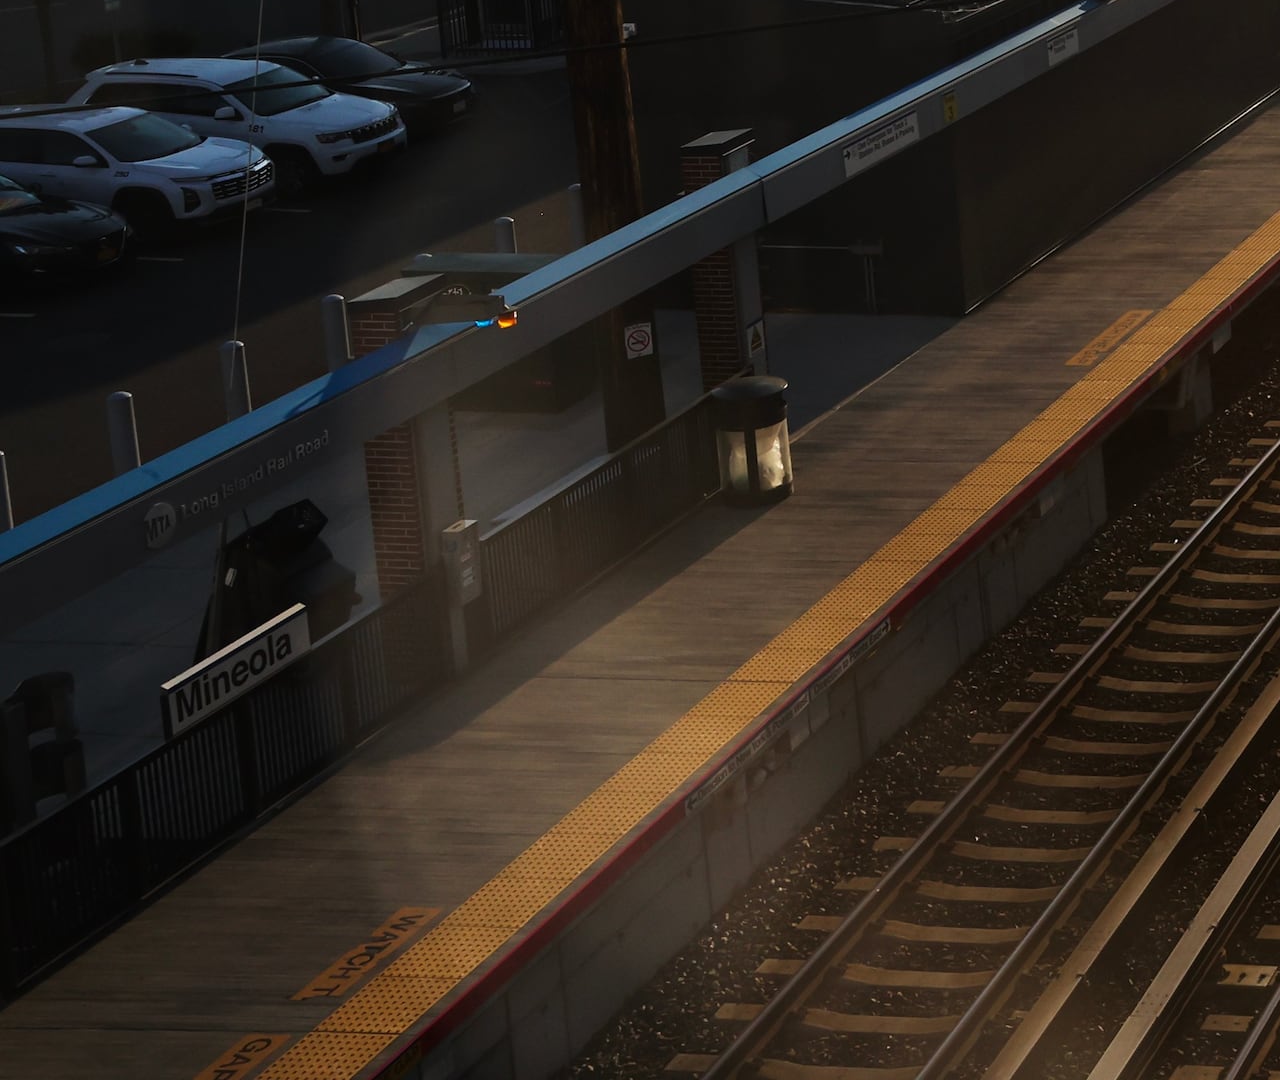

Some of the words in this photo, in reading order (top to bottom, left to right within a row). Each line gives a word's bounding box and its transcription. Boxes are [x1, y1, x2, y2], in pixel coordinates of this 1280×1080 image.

[249, 124, 264, 133] 181
[180, 491, 220, 517] Long
[222, 466, 264, 499] Island
[266, 449, 293, 477] Rail
[295, 428, 329, 461] Road
[175, 633, 293, 723] Mineola
[330, 914, 425, 980] WATCH
